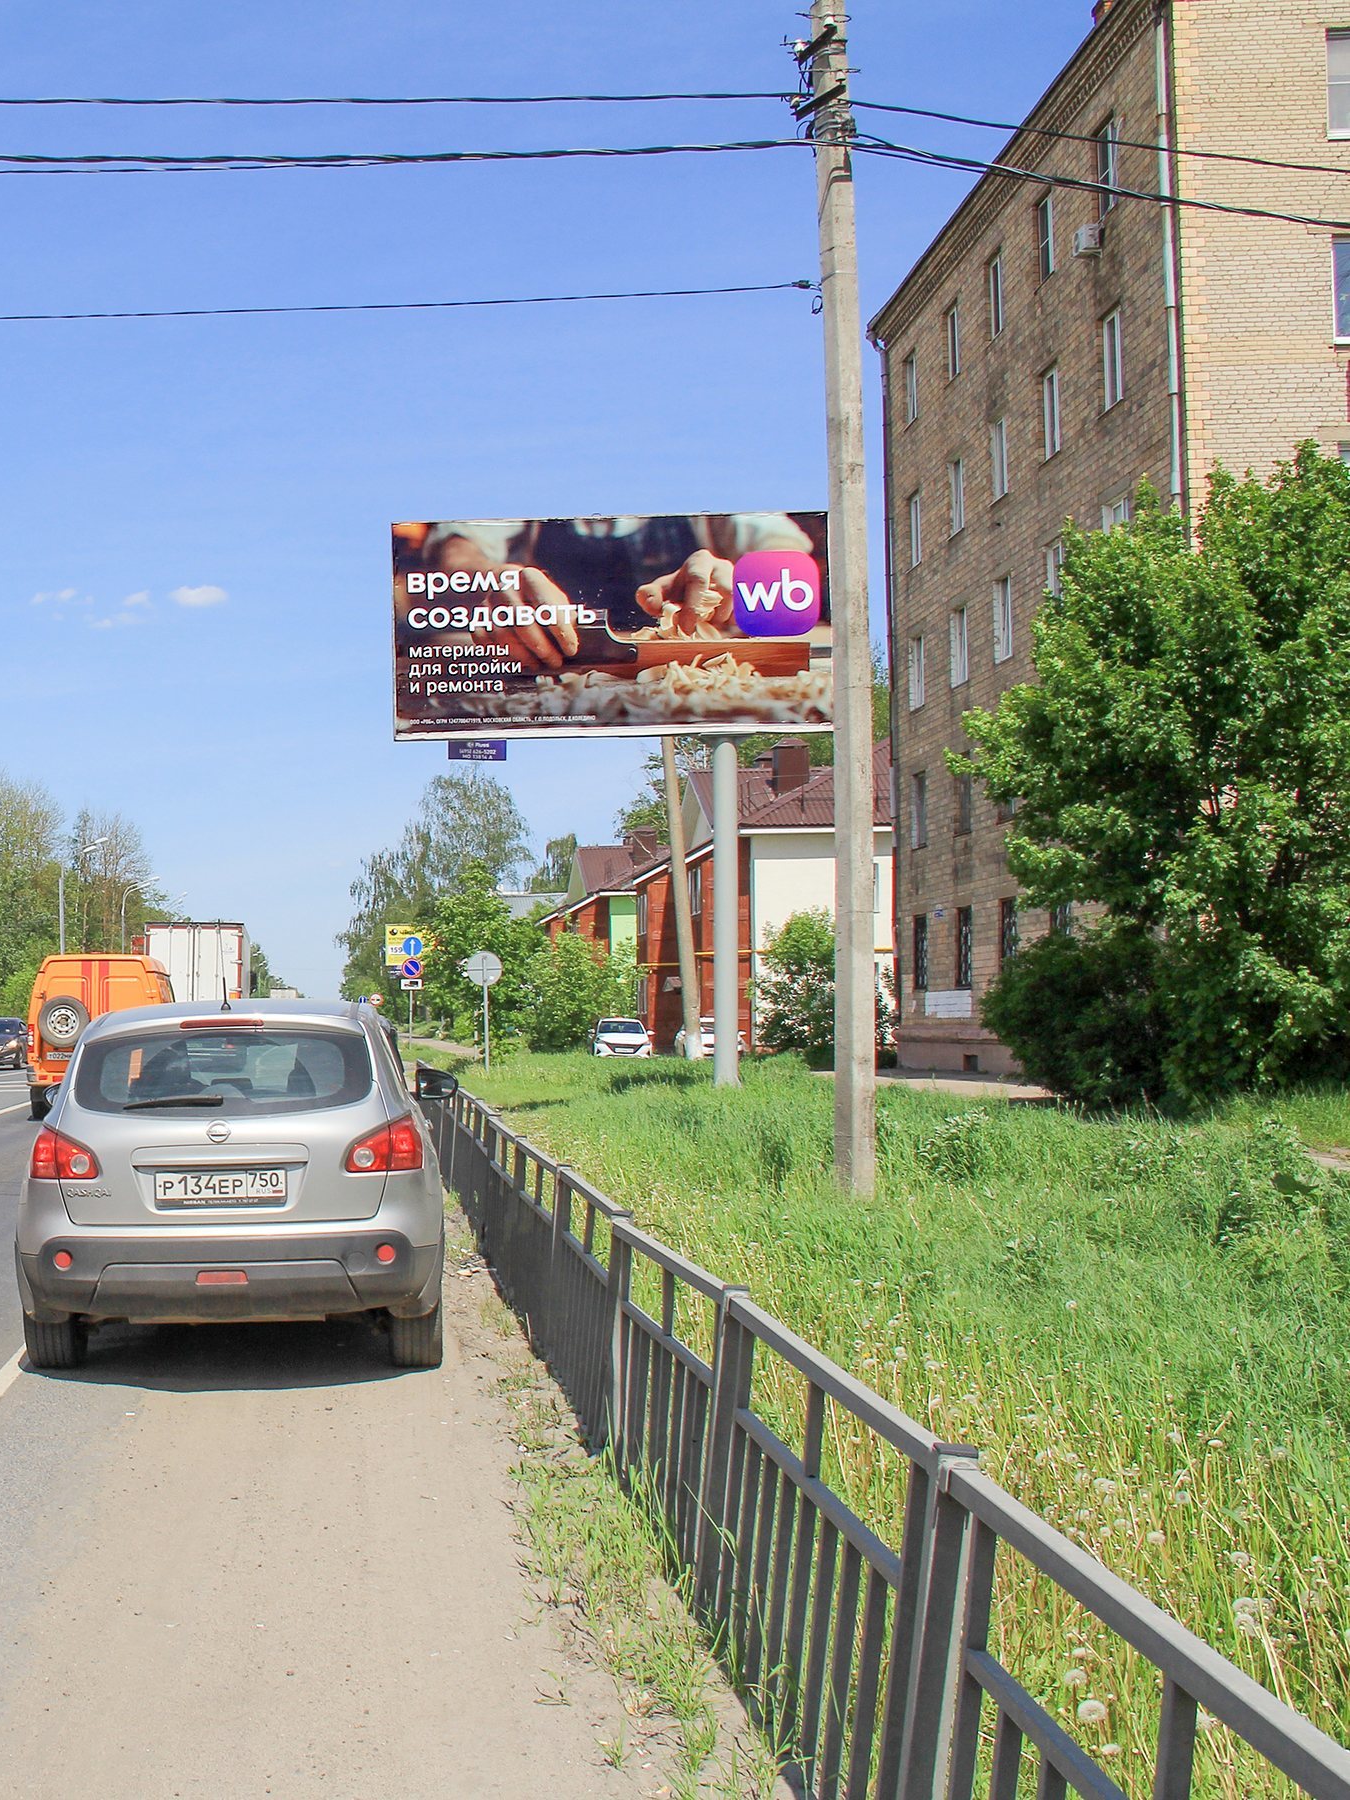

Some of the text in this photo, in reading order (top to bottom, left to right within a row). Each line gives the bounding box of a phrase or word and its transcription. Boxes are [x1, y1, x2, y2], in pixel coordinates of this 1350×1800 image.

[407, 570, 521, 600] время
[737, 568, 814, 612] wb
[407, 603, 596, 631] создавать
[409, 643, 509, 660] материалы
[408, 659, 522, 678] для стройки
[409, 679, 504, 696] и ремонта
[248, 1172, 280, 1188] 750
